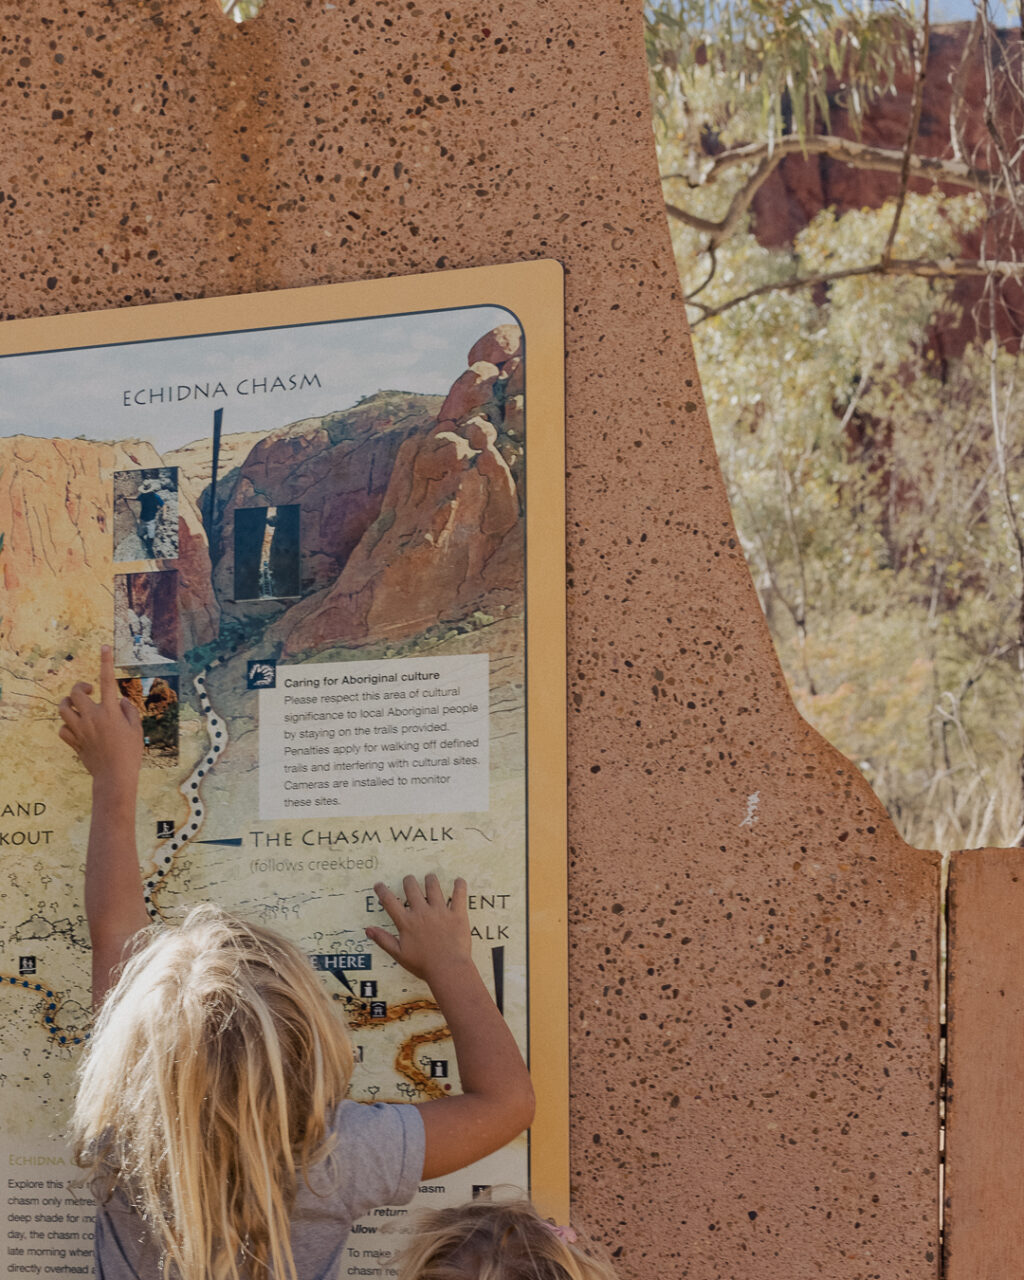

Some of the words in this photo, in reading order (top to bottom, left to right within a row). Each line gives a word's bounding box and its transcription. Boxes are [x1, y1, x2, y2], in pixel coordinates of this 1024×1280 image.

[123, 381, 229, 407] ECHIDNA
[236, 373, 322, 396] CHASM
[284, 677, 321, 689] Caring
[323, 676, 338, 686] for
[341, 673, 398, 686] Aboriginal
[400, 671, 441, 682] culture
[284, 695, 318, 705] Please
[320, 693, 360, 705] respect
[362, 692, 381, 701] this
[383, 690, 406, 700] area
[409, 688, 419, 699] of
[422, 686, 461, 698] cultural
[284, 711, 344, 724] significance
[347, 710, 358, 719] to
[360, 708, 384, 719] local
[387, 704, 440, 718] Aboriginal
[442, 703, 479, 716] people
[284, 730, 295, 740] by
[299, 728, 336, 740] staying
[338, 728, 352, 737] on
[354, 726, 371, 736] the
[373, 724, 399, 735] trails
[401, 722, 450, 735] provided.
[284, 745, 330, 756] Penalties
[333, 744, 361, 756] apply
[363, 743, 378, 753] for
[381, 741, 420, 753] walking
[422, 739, 437, 750] off
[439, 738, 480, 749] defined
[284, 764, 309, 773] trails
[311, 762, 331, 772] and
[333, 760, 385, 772] interfering
[387, 758, 409, 768] with
[412, 757, 450, 768] cultural
[452, 756, 480, 766] sites.
[284, 780, 330, 790] Cameras
[332, 780, 349, 788] are
[351, 777, 395, 788] installed
[397, 776, 408, 785] to
[411, 775, 451, 785] monitor
[284, 798, 312, 807] these
[314, 796, 341, 807] sites.
[249, 831, 293, 848] THE
[302, 829, 382, 846] CHASM
[389, 826, 454, 842] WALK
[249, 857, 304, 874] (follows
[308, 856, 380, 872] creekbed)
[324, 955, 366, 969] HERE
[9, 1154, 66, 1166] ECHIDNA
[7, 1178, 44, 1190] Explore
[46, 1179, 64, 1189] this
[7, 1196, 39, 1206] chasm
[42, 1197, 62, 1207] only
[7, 1213, 32, 1223] deep
[34, 1213, 64, 1223] shade
[66, 1214, 80, 1223] for
[7, 1230, 27, 1241] day,
[29, 1230, 45, 1239] the
[47, 1231, 80, 1240] chasm
[7, 1246, 24, 1256] late
[26, 1247, 66, 1259] morning
[347, 1247, 360, 1258] To
[362, 1248, 392, 1258] make
[7, 1263, 41, 1275] directly
[44, 1264, 89, 1274] overhead
